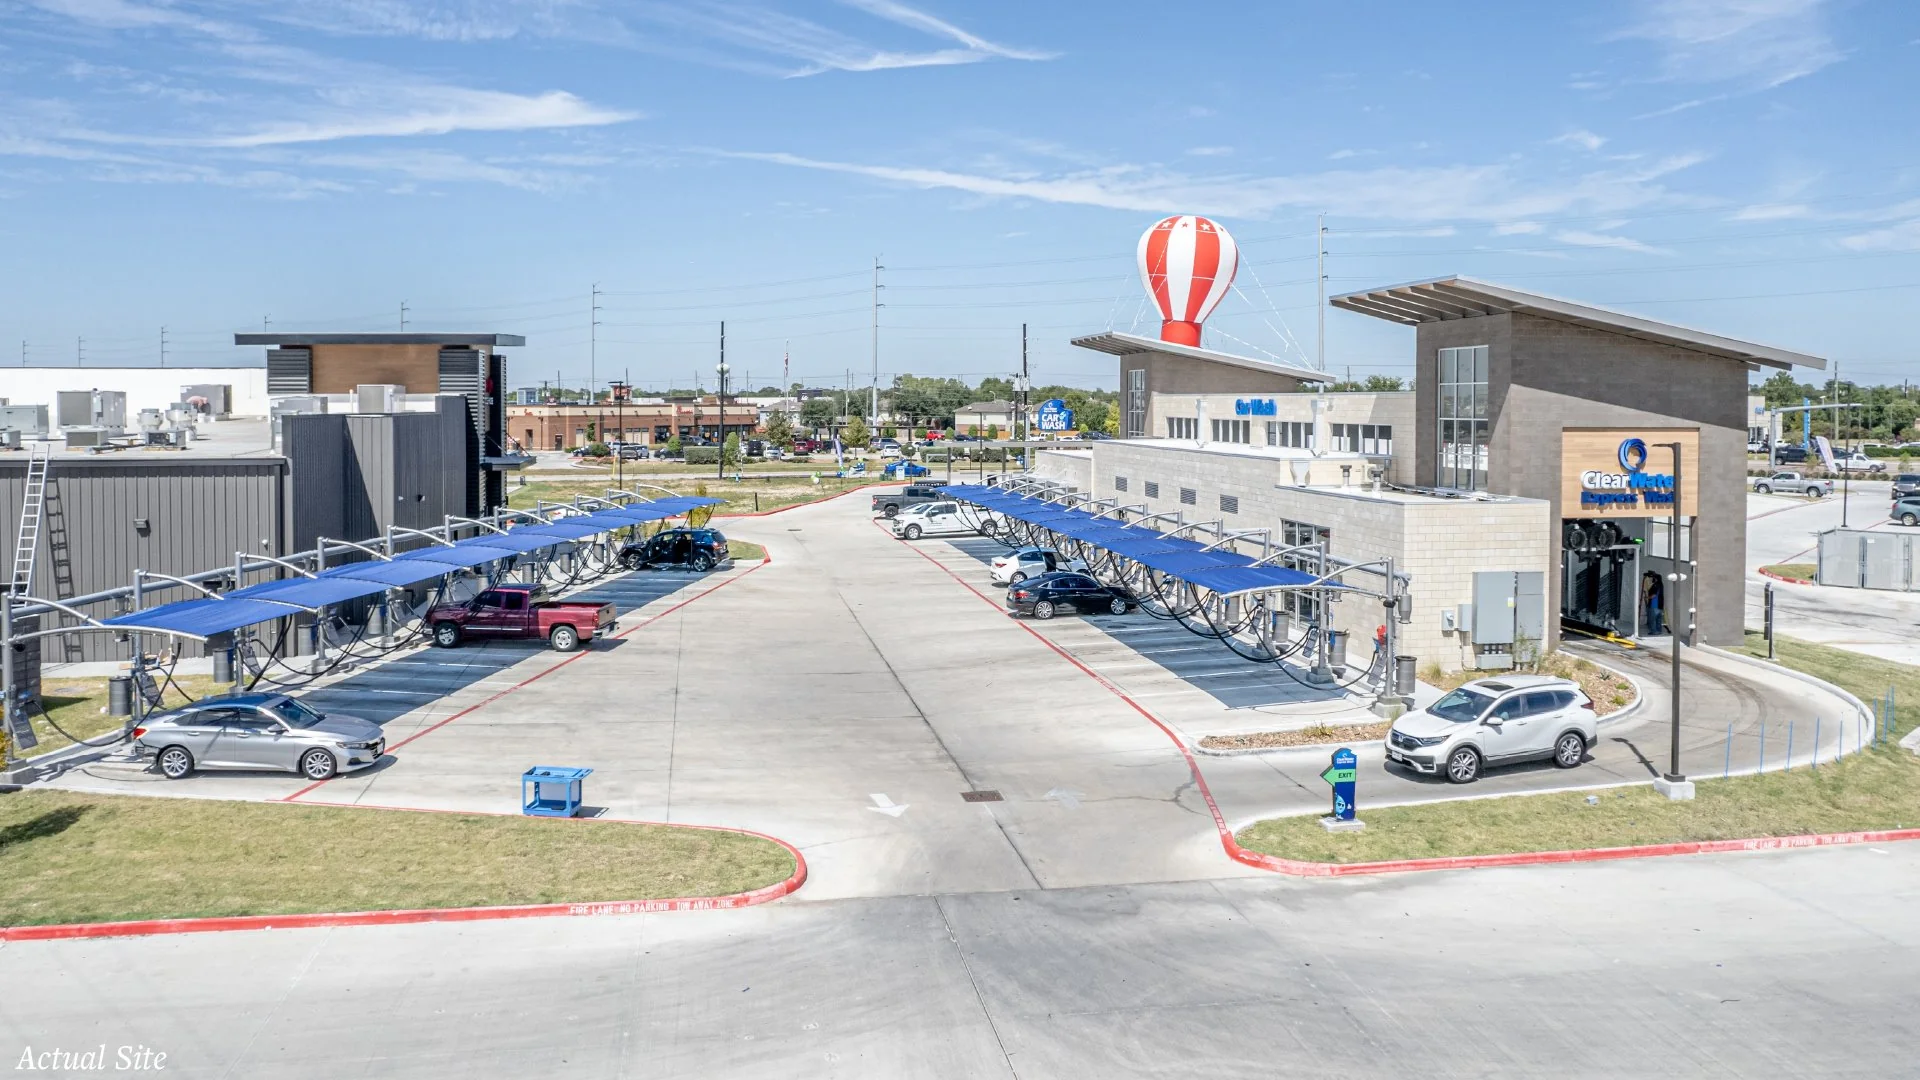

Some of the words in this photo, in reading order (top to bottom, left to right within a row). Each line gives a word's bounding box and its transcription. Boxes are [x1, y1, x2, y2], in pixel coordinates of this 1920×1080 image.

[1042, 413, 1059, 422] CAR
[1042, 422, 1066, 430] WASH
[1580, 470, 1676, 490] ClearWate
[1581, 491, 1638, 506] Express
[1643, 490, 1676, 504] Was
[570, 905, 588, 914] FIRE
[592, 905, 614, 915] LANE
[620, 903, 631, 913] NO
[634, 902, 669, 913] PARKING
[677, 901, 691, 912] TOW
[694, 900, 713, 910] AWAY
[717, 899, 735, 909] ZONE
